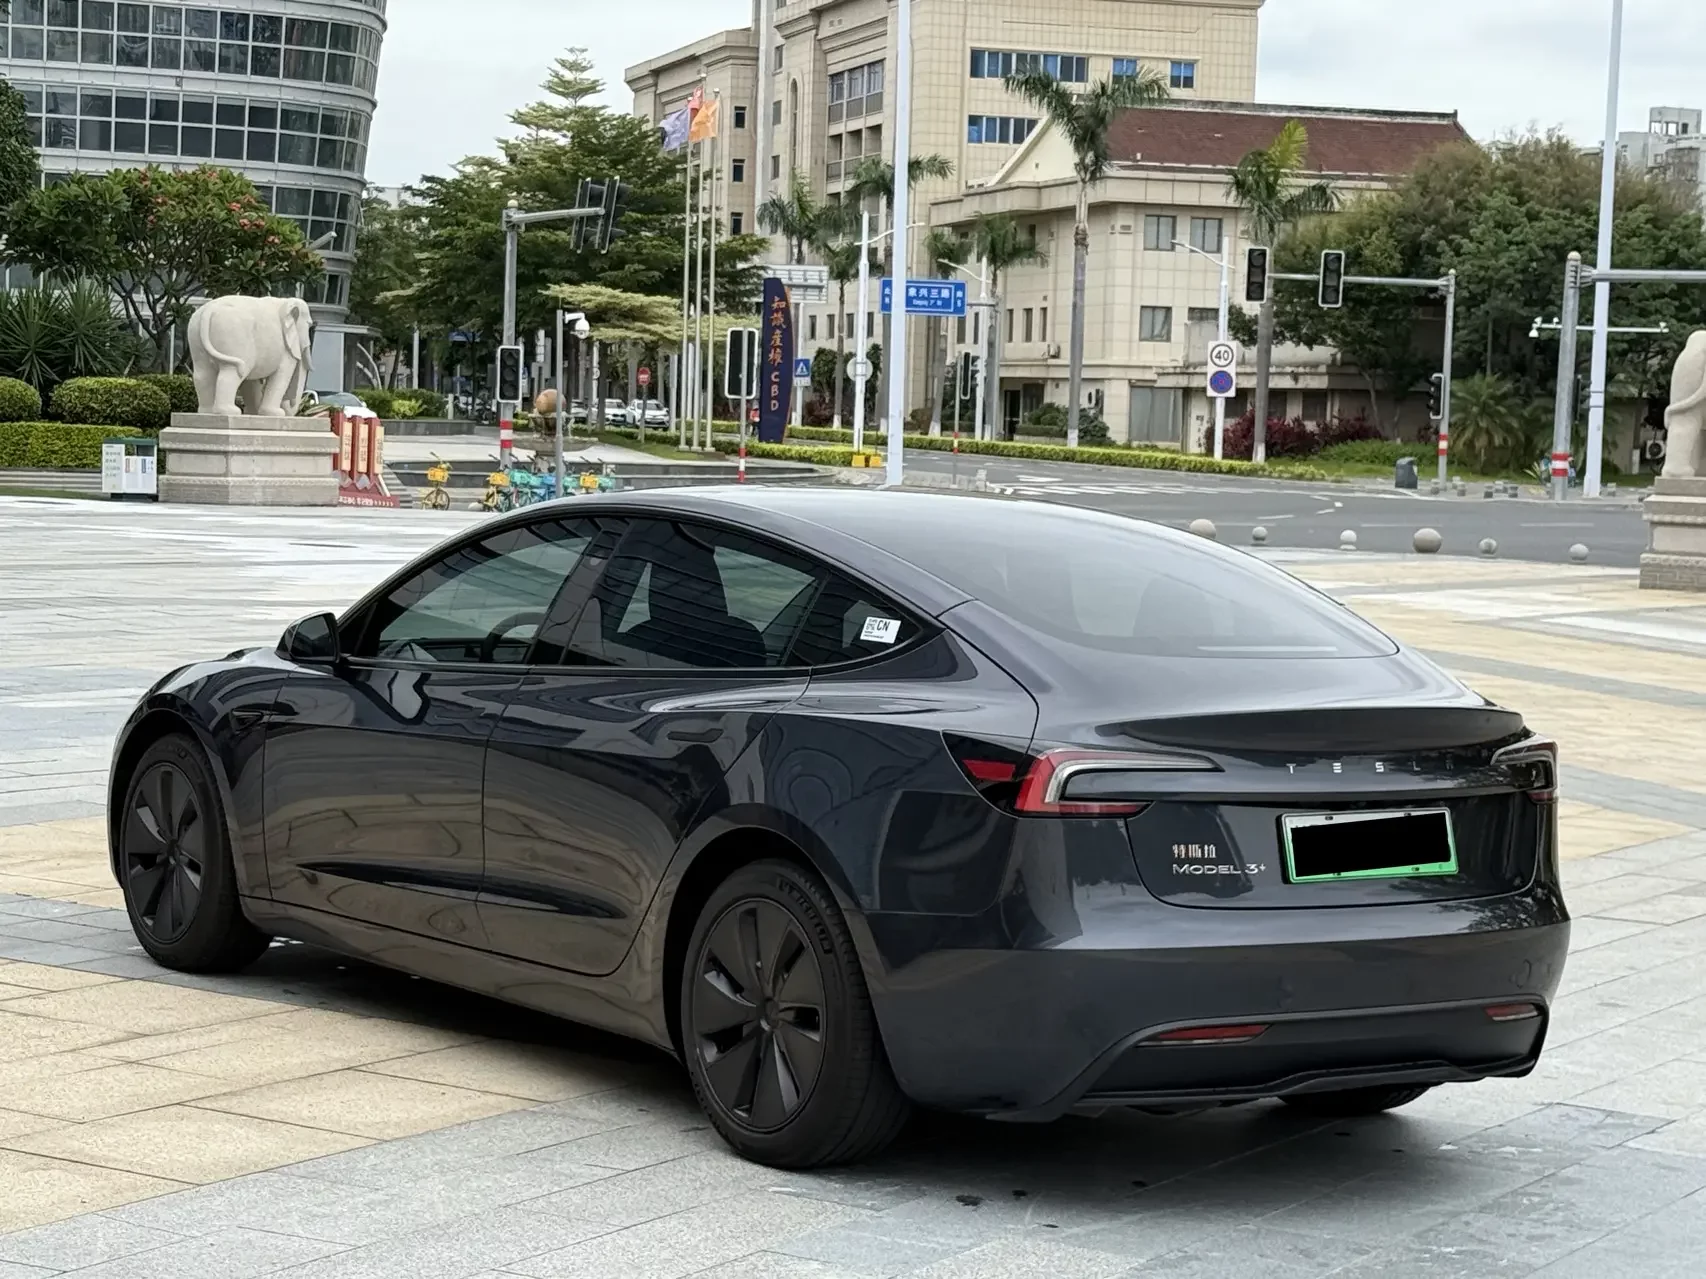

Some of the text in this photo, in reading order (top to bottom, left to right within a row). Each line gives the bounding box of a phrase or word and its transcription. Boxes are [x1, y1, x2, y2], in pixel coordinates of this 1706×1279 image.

[1214, 350, 1230, 362] 40
[876, 620, 891, 632] CN
[1172, 844, 1217, 859] 特斯拉
[1173, 863, 1242, 875] MODEL
